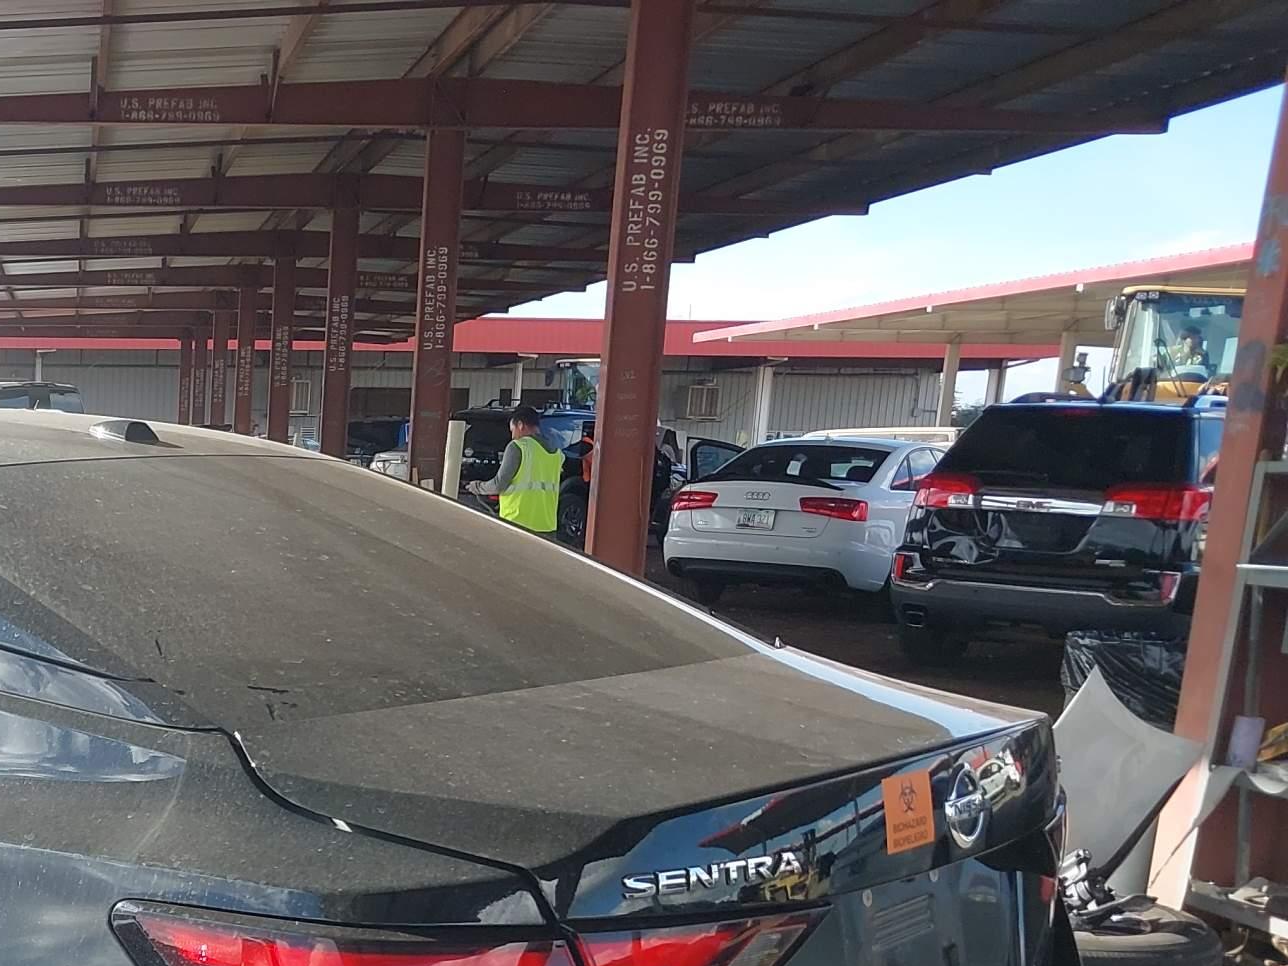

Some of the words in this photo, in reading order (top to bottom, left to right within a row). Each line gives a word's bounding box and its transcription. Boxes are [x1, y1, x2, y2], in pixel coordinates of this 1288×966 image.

[120, 98, 142, 110] U.S.
[148, 97, 194, 110] PREFAB
[708, 102, 755, 114] PREFAB
[632, 128, 652, 163] INC.
[626, 173, 647, 246] PREFAB
[640, 129, 669, 290] 1-866-799-0969
[426, 246, 438, 269] INC.
[622, 256, 640, 292] U.S.
[424, 275, 436, 321] PREFAB
[435, 247, 449, 349] 1-866-799-0969
[423, 326, 434, 350] U.S.
[622, 851, 804, 899] SENTRA
